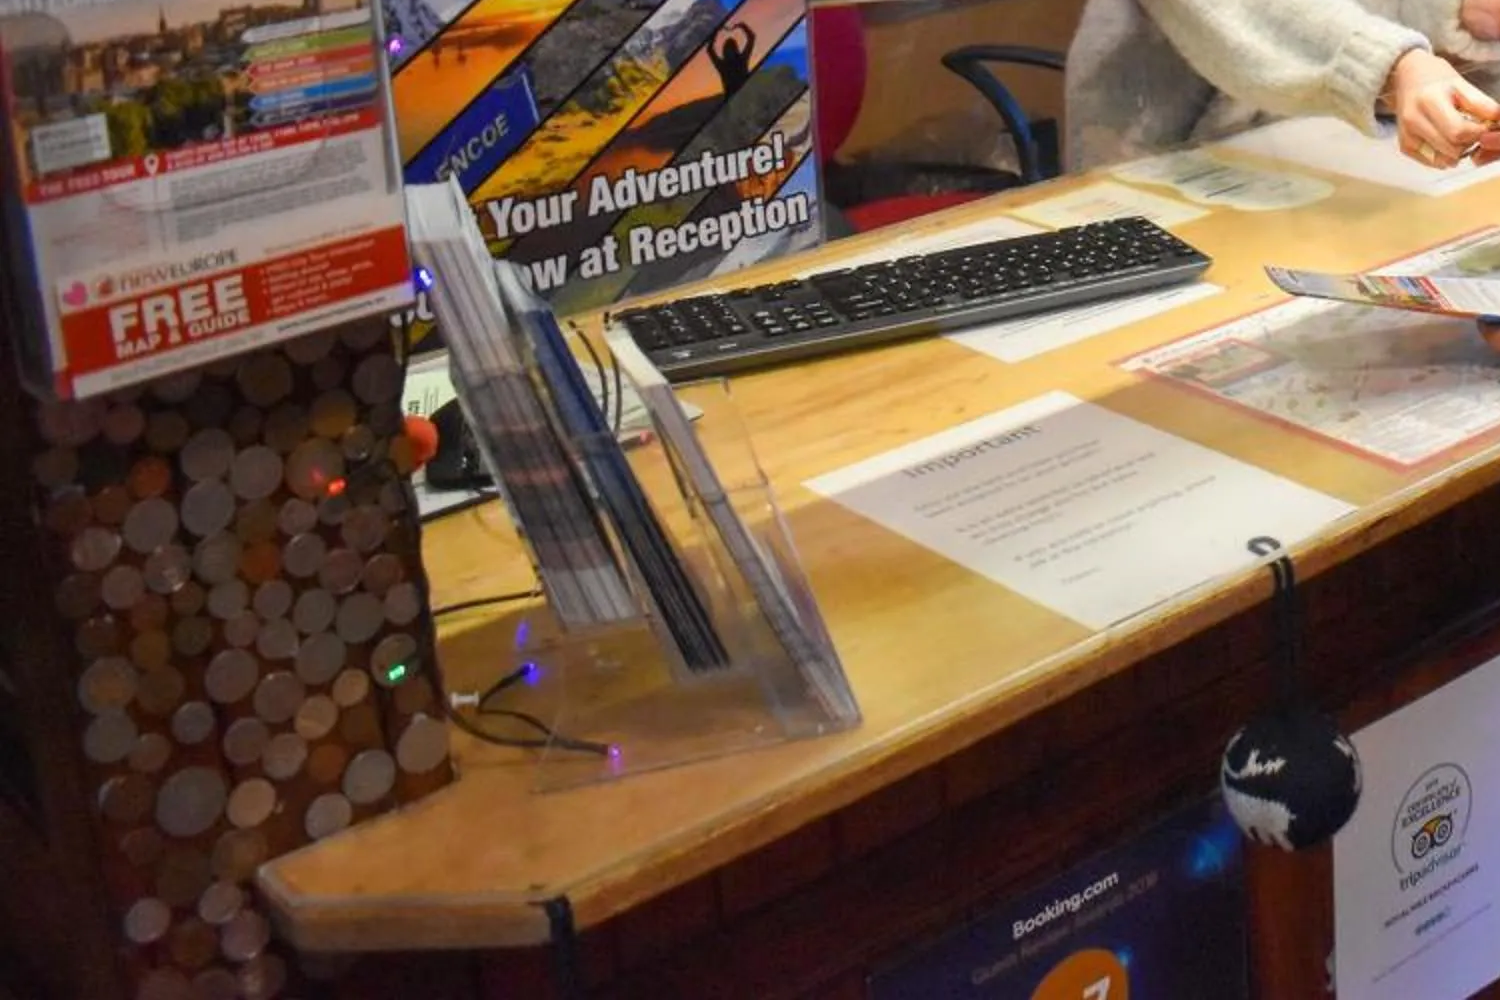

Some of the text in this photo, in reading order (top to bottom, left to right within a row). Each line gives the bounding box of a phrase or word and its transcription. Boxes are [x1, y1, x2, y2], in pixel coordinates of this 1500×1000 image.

[436, 113, 510, 182] ENCOE
[488, 132, 785, 239] Your Adventure!
[580, 236, 620, 280] at
[630, 193, 809, 267] Reception
[109, 273, 249, 343] FREE
[188, 308, 251, 339] GUIDE
[903, 422, 1043, 480] Important
[1013, 872, 1120, 940] Booking.com
